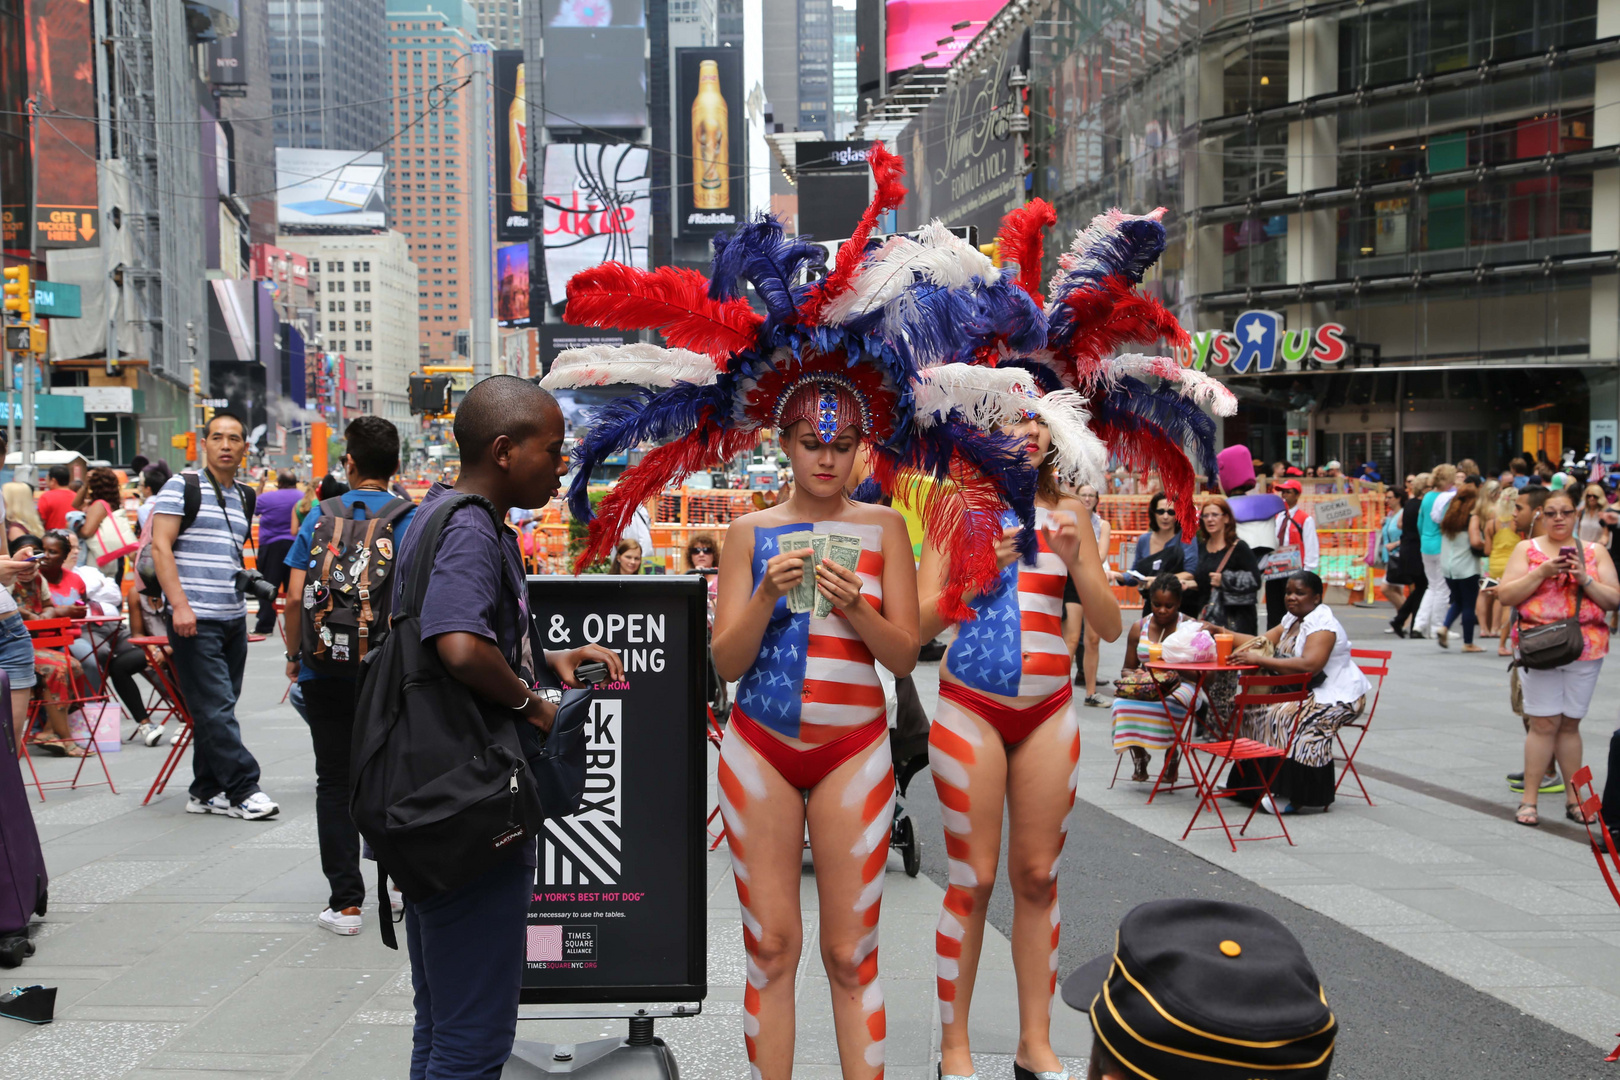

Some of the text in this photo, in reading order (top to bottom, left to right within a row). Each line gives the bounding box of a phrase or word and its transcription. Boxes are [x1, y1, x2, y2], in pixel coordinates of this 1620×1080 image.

[50, 211, 77, 222] GET
[37, 221, 77, 231] TICKETS
[47, 231, 77, 241] HERE
[202, 398, 228, 407] SUNG
[548, 613, 665, 644] & OPEN
[495, 831, 523, 847] EASTPAK
[530, 893, 542, 902] EW
[544, 893, 576, 902] YORK'S
[578, 893, 600, 902] BEST
[602, 893, 620, 902] HOT
[539, 911, 571, 920] necessary
